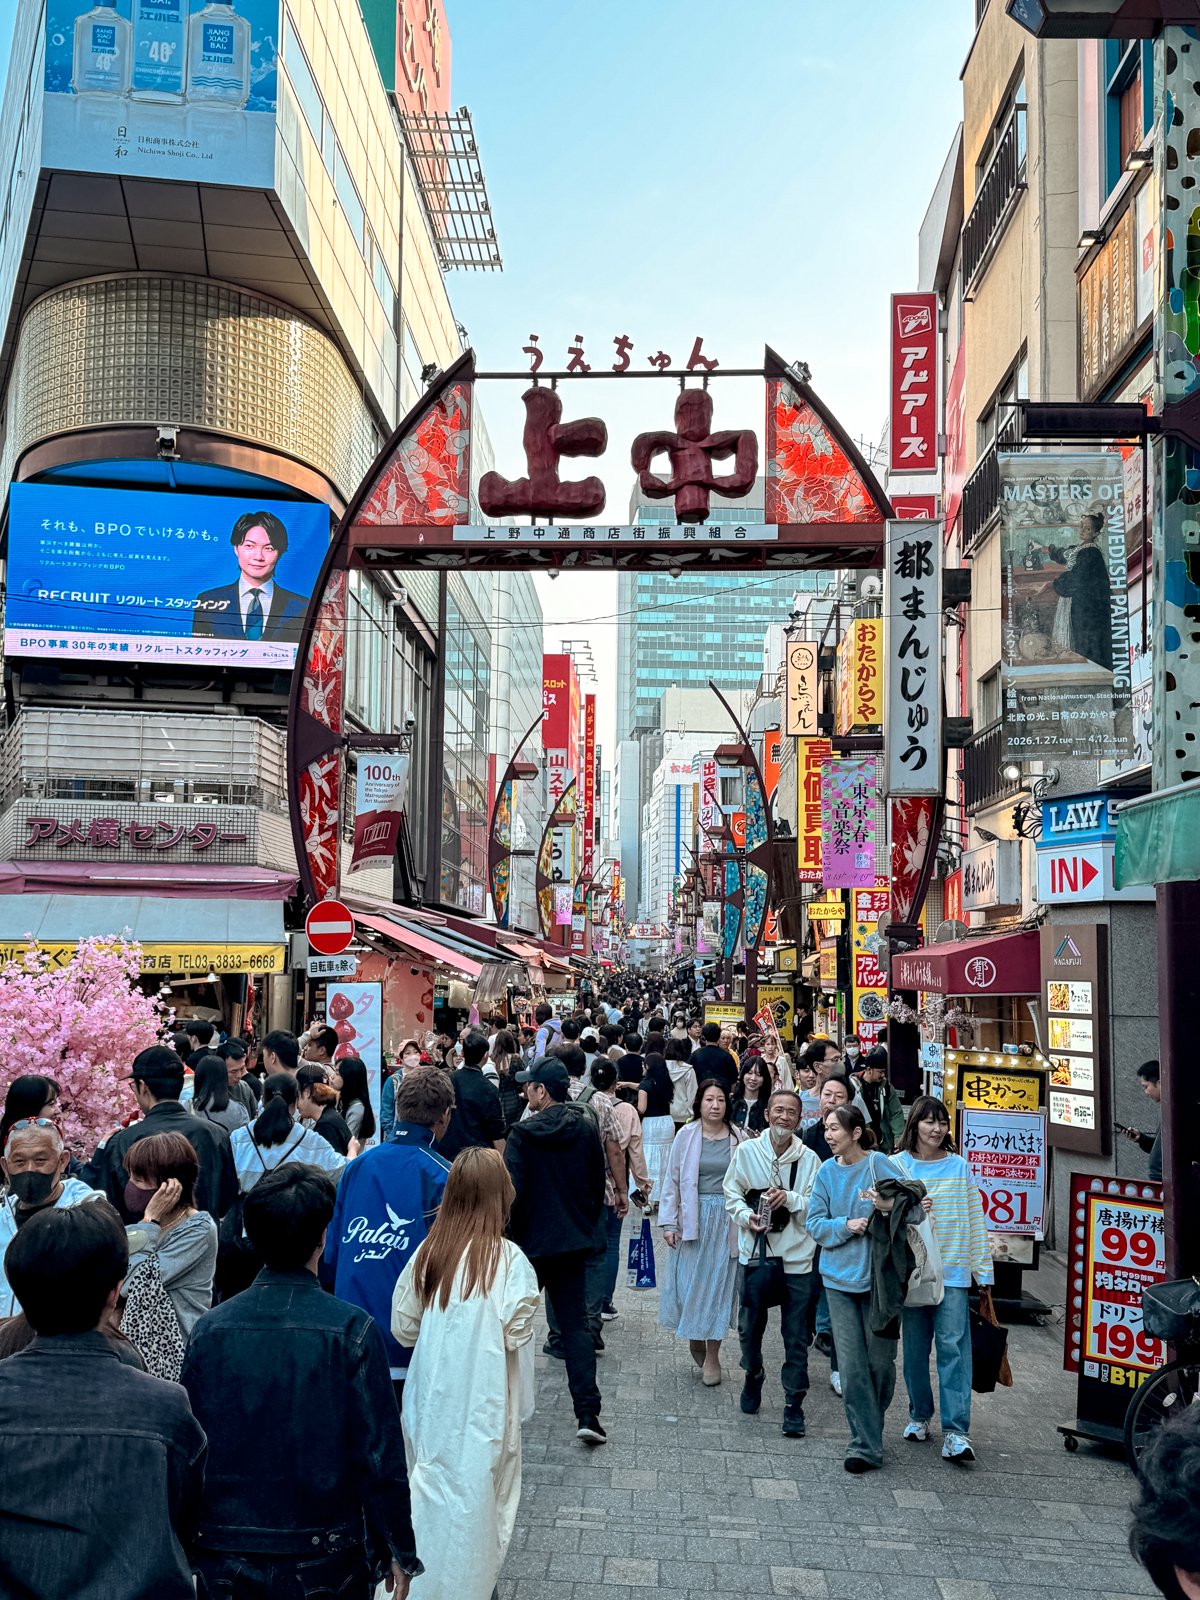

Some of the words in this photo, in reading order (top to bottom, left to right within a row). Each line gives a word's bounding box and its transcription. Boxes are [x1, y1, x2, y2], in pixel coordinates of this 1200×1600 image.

[207, 28, 230, 36] JIANG
[210, 42, 227, 50] BAI.
[137, 135, 200, 149] 日和商事株式会社
[137, 146, 165, 156] Nichiwa
[167, 149, 184, 158] Shoji
[201, 152, 213, 160] Ltd
[522, 334, 719, 373] うえちゅん
[899, 346, 929, 458] アドアーズ
[478, 386, 759, 524] 上中
[1003, 484, 1093, 502] MASTERS
[1097, 483, 1123, 500] OF
[40, 518, 220, 543] それも、BPOでいけるかも。
[484, 526, 748, 540] 上野中通商店街振興組合
[1107, 504, 1127, 590] SWEDISH
[38, 588, 111, 604] RECRUIT
[115, 594, 163, 606] リクルート
[165, 597, 231, 611] スタッフィング
[20, 638, 69, 650] BPO事業
[72, 639, 130, 653] 30年の実績
[135, 643, 250, 658] リクルートスタッフィング
[1109, 595, 1131, 688] PAINTING
[893, 539, 936, 771] 都まんじゅう
[857, 622, 877, 722] おたからや
[1097, 692, 1131, 700] Stockholm
[1006, 710, 1118, 722] 北欧の光、日常のかがやき
[364, 765, 400, 781] 100th
[25, 815, 247, 850] アメ横センター
[833, 802, 851, 855] 音楽祭
[1050, 857, 1079, 893] IN
[808, 906, 845, 916] おたからや
[857, 892, 872, 909] 金
[178, 953, 275, 970] TEL03-3833-6668
[310, 959, 354, 973] 自転車を除く
[857, 971, 888, 986] バッグ
[966, 1075, 1027, 1102] 串かつ
[964, 1128, 1036, 1154] おつかれさま
[970, 1152, 1039, 1166] お好きなドリンク1杯
[983, 1166, 1035, 1180] 串かつ5本セット
[1097, 1208, 1165, 1235] 唐揚げ棒
[342, 1216, 410, 1250] Palais
[353, 1247, 392, 1263] لندن
[1101, 1227, 1156, 1267] 99
[1155, 1259, 1165, 1270] 円
[1092, 1321, 1163, 1366] 199
